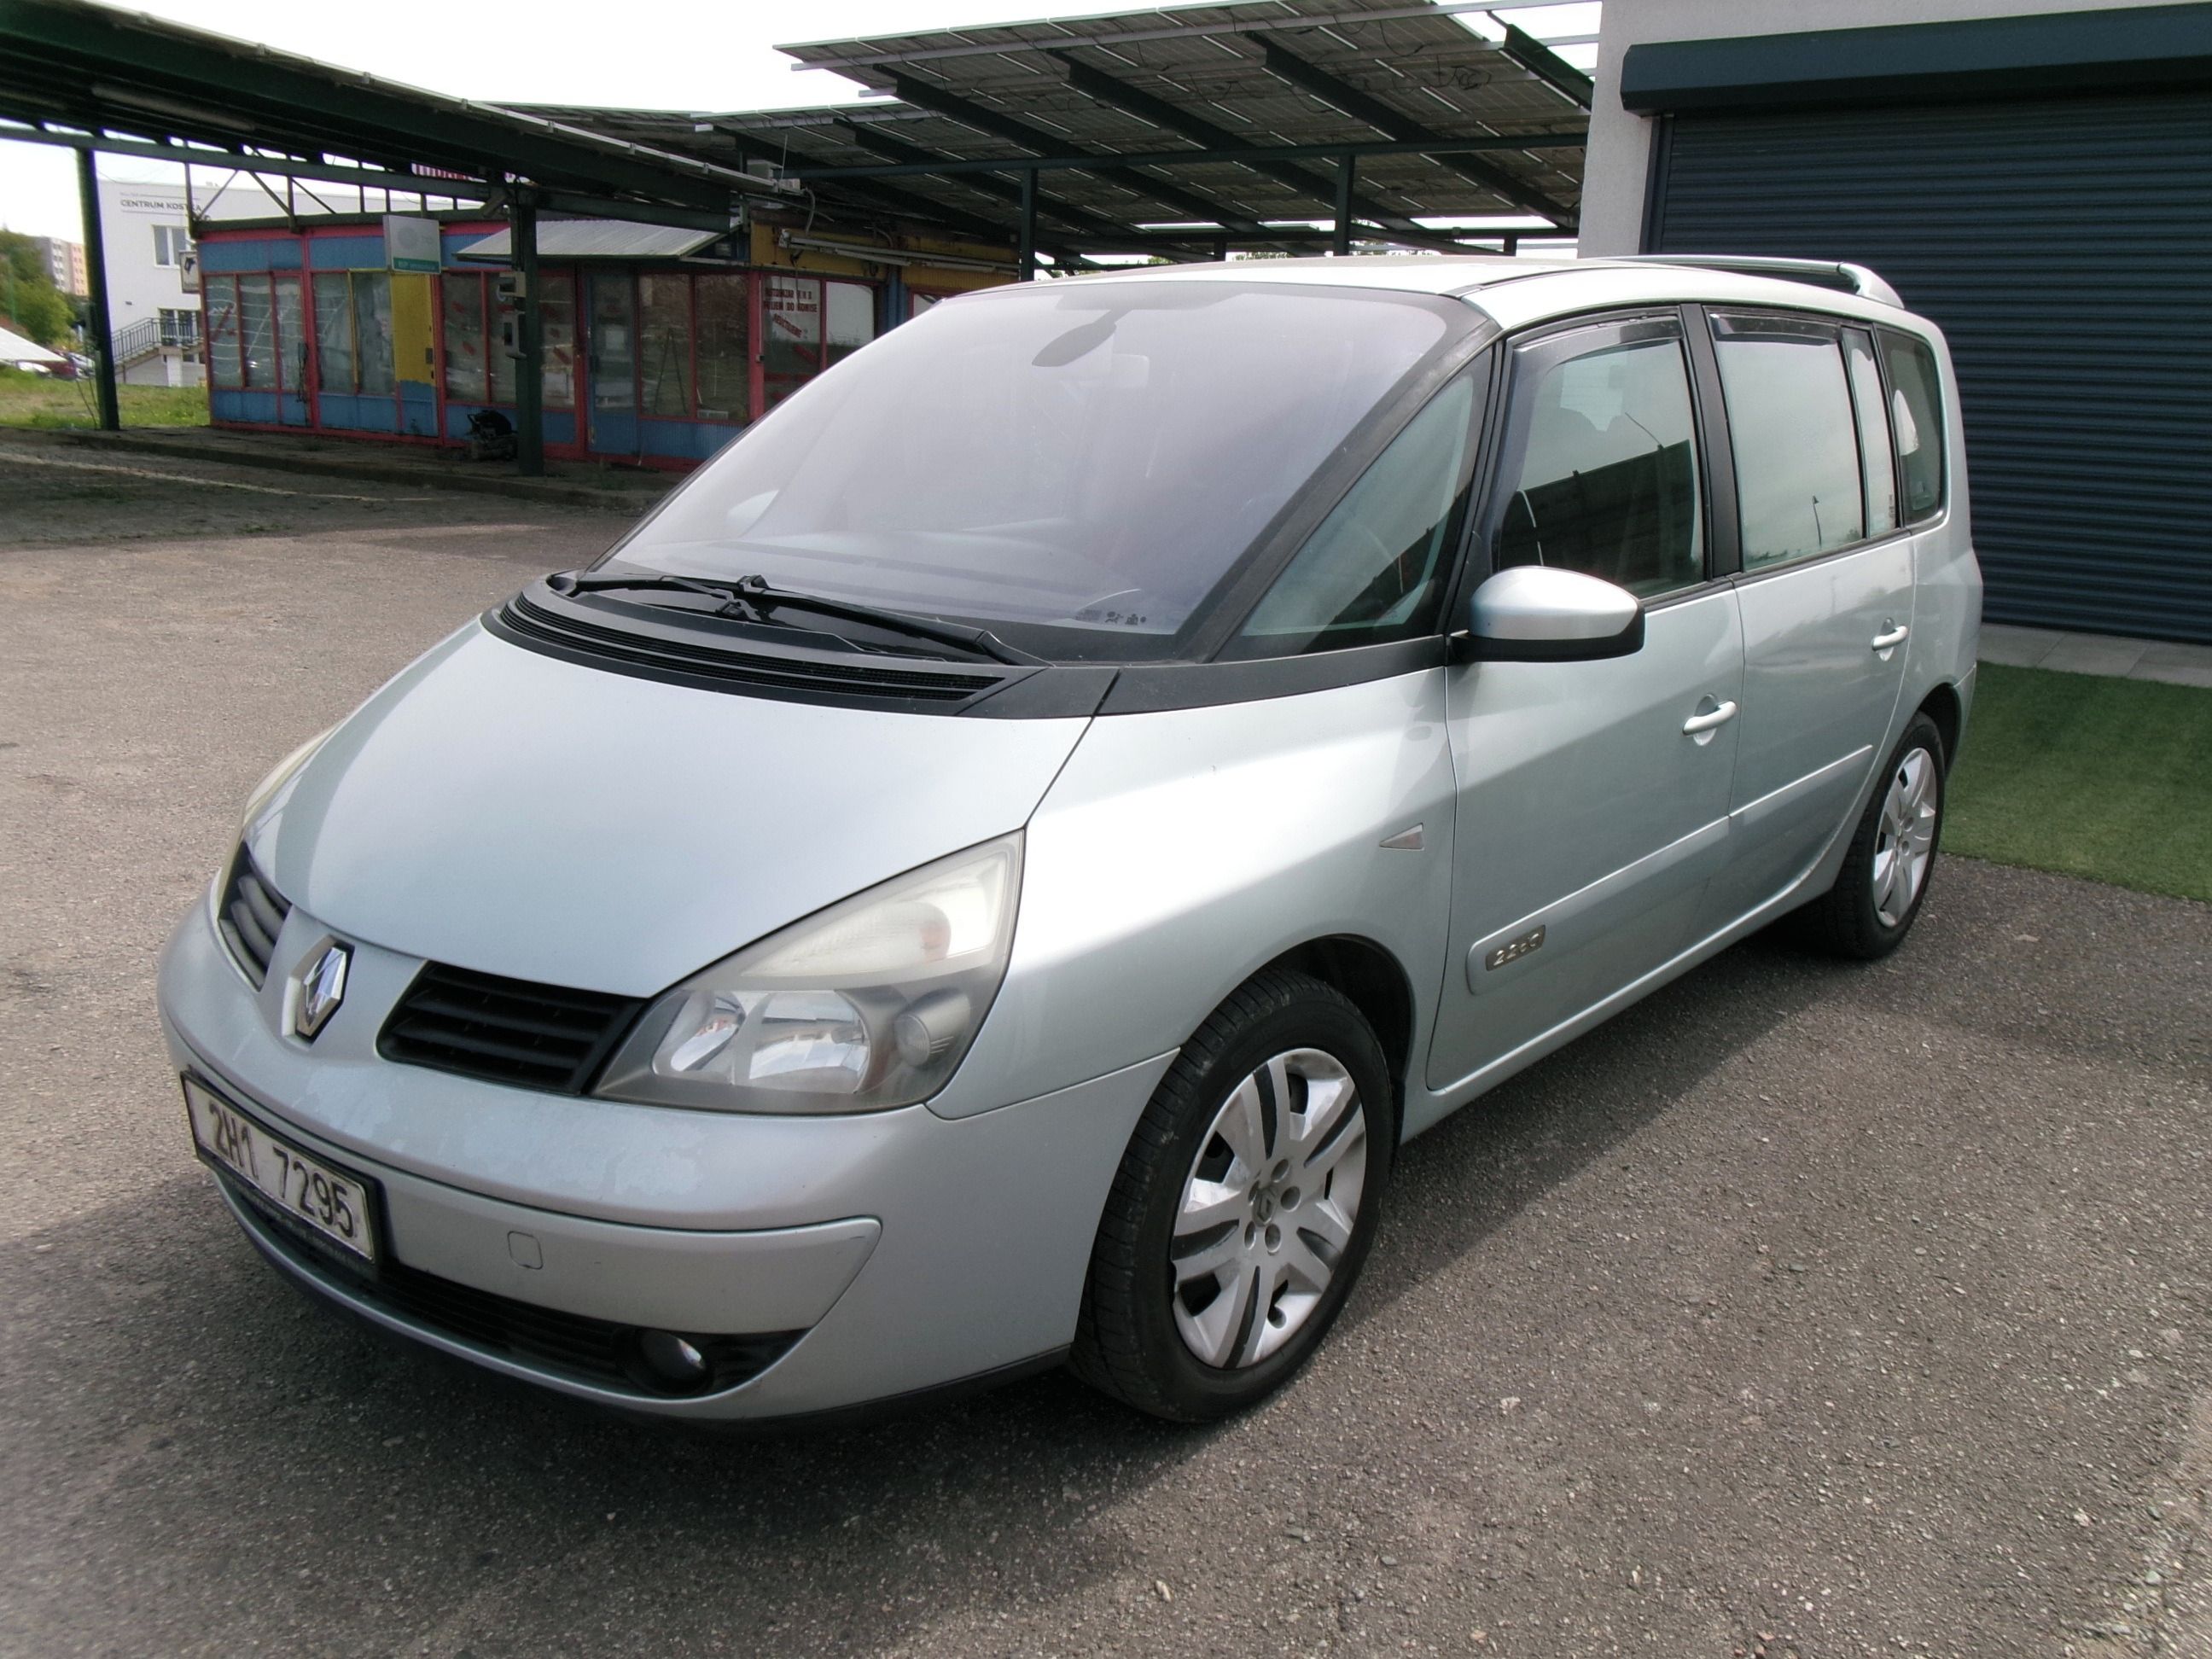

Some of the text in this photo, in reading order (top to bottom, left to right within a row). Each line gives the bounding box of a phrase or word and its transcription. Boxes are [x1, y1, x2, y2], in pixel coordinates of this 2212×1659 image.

[120, 198, 202, 212] CENTRUM KOSA
[209, 1100, 259, 1181] 2H1
[273, 1146, 354, 1238] 7295
